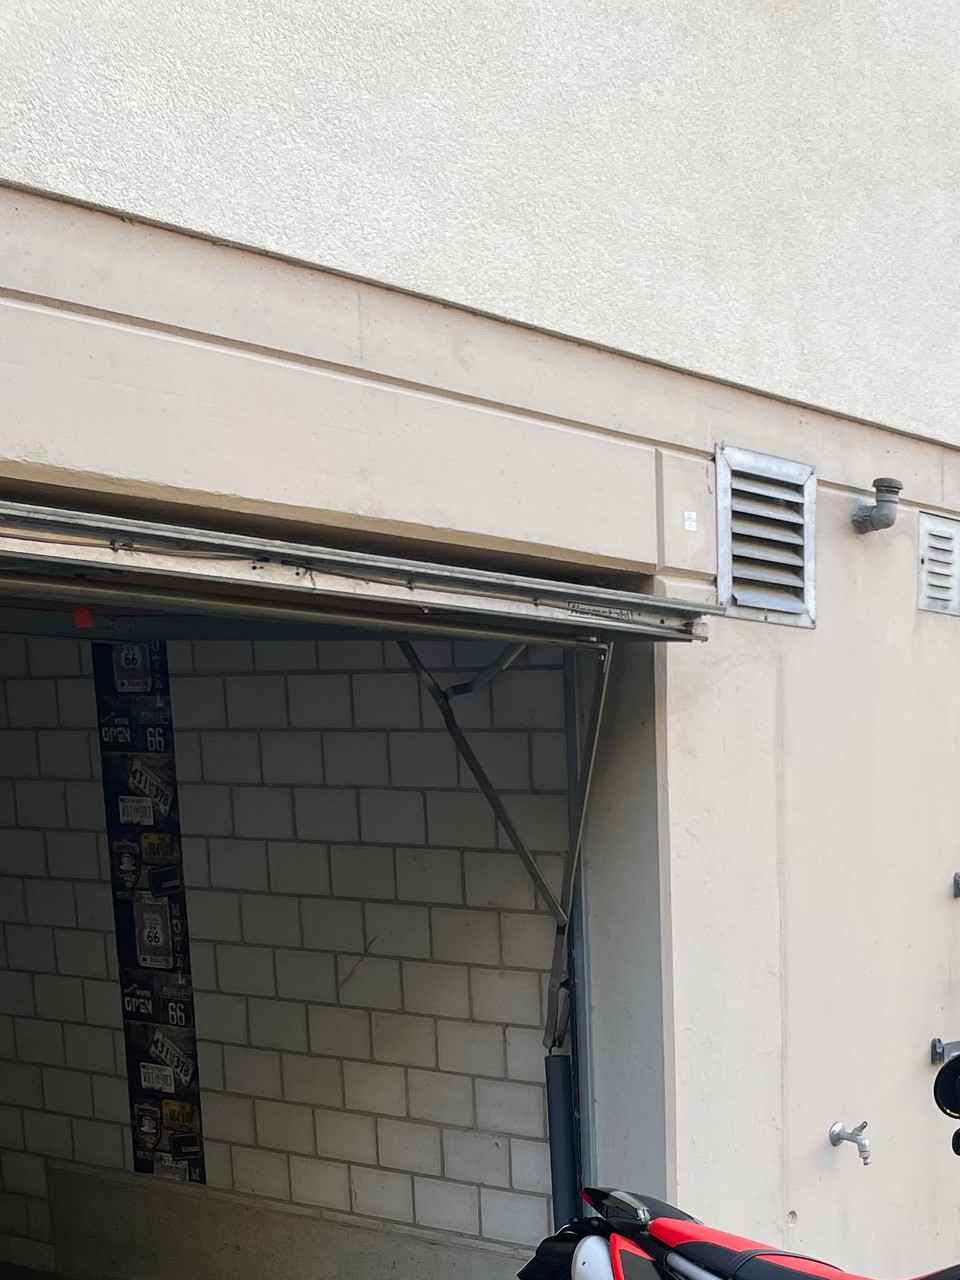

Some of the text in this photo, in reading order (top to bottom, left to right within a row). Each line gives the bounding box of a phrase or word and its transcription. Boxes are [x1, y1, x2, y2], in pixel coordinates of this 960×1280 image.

[124, 652, 138, 666] 66
[102, 726, 131, 743] OPEN
[146, 727, 165, 752] 66
[146, 931, 160, 944] 66
[124, 997, 153, 1014] OPEN
[168, 1002, 186, 1026] 66
